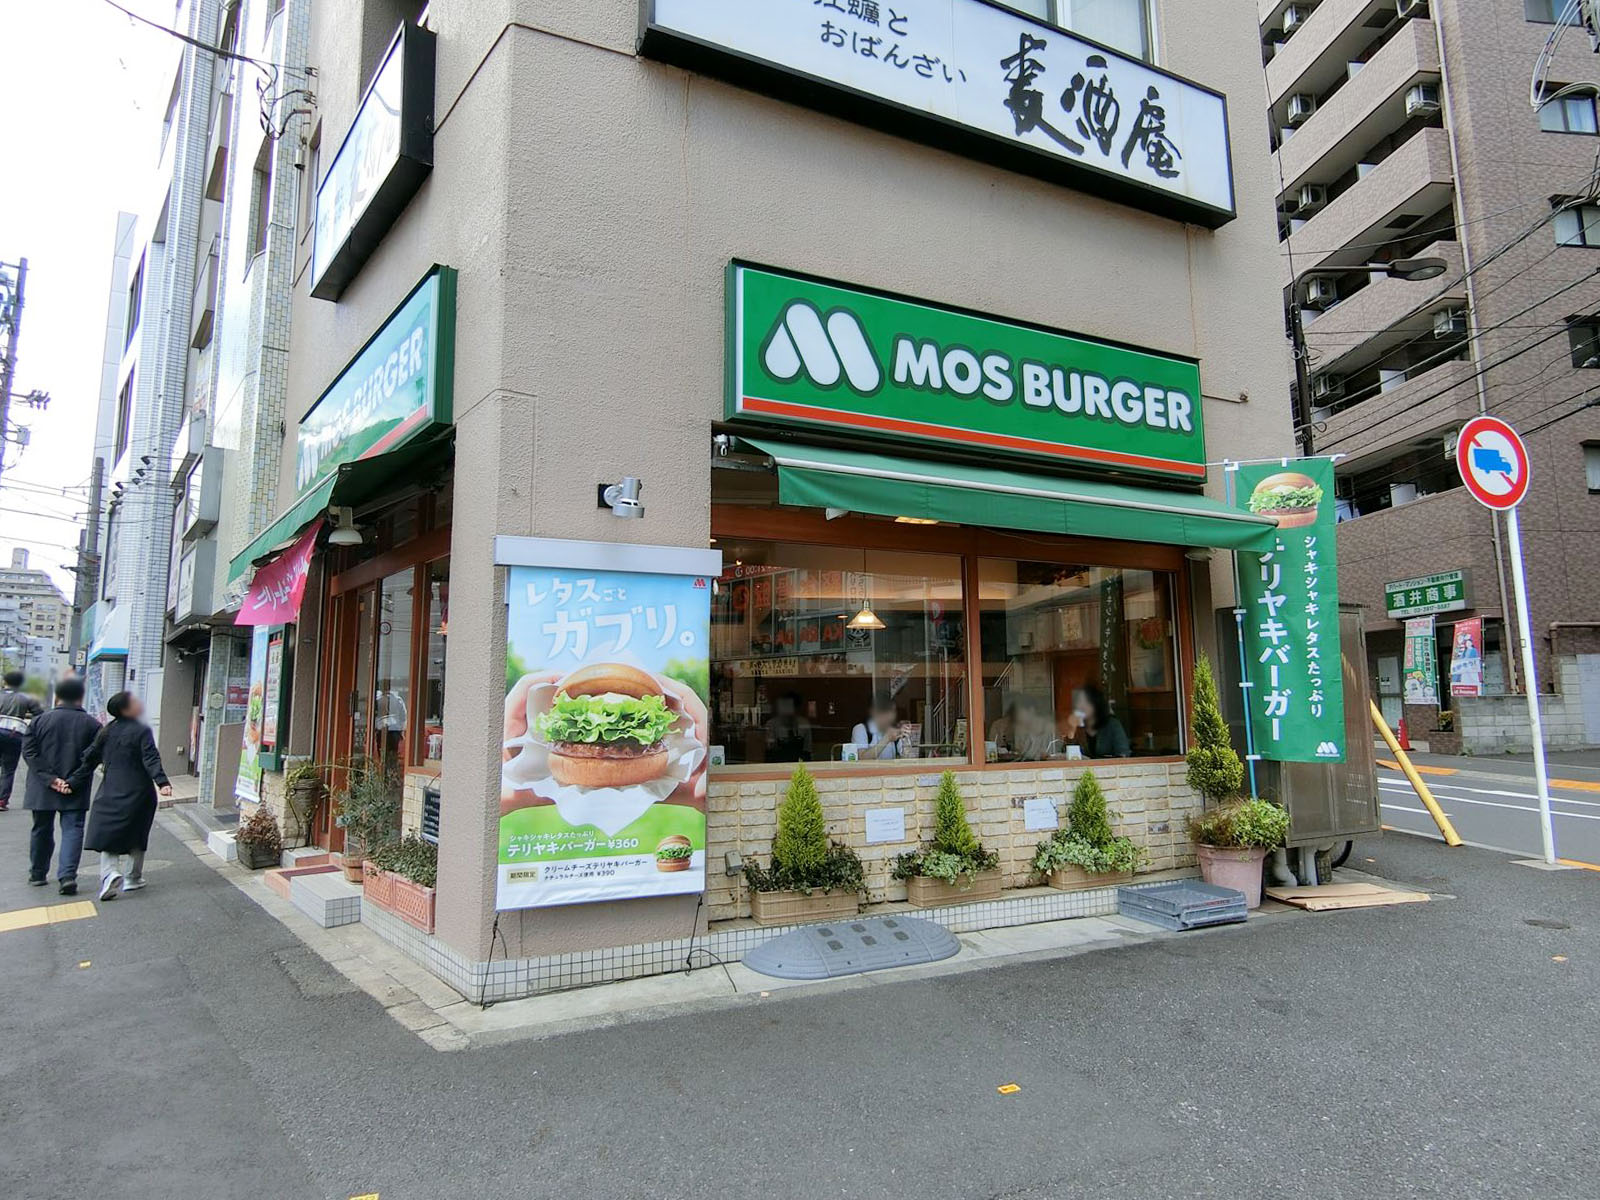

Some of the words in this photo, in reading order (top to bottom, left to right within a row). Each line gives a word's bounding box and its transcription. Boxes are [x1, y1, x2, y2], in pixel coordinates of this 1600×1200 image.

[820, 20, 967, 83] おばんざい
[352, 326, 425, 420] BURGER
[893, 338, 1014, 401] MOS
[1022, 362, 1193, 433] BURGER
[526, 577, 627, 606] レタスごと
[1392, 583, 1457, 608] 酒井商事
[542, 604, 696, 660] ガブリ。
[1257, 537, 1292, 742] リヤキバーガー
[1303, 535, 1324, 718] シャキシャキレタスたっぷり
[507, 838, 607, 857] テリヤキバーガー
